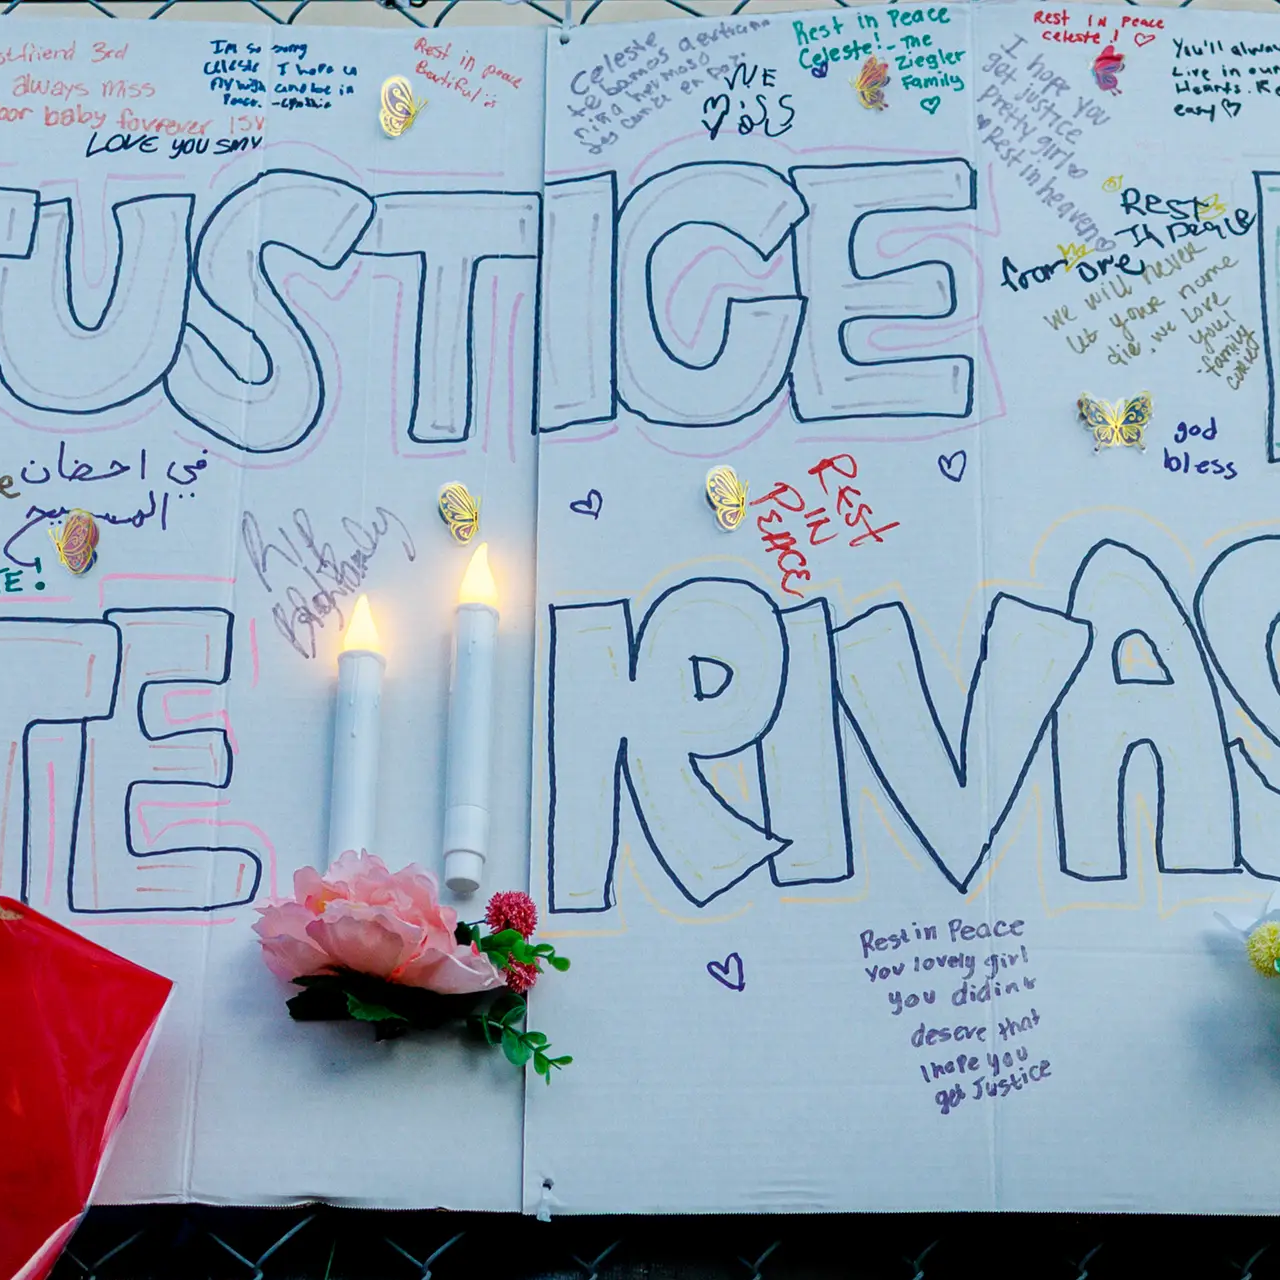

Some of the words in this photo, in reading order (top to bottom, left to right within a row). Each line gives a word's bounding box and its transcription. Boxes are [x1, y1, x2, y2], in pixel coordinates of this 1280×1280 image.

[792, 16, 844, 46] Rest
[857, 12, 879, 29] in
[414, 36, 452, 60] Rest
[459, 49, 476, 72] in
[570, 31, 658, 96] Celeste
[1000, 33, 1028, 59] I
[1026, 53, 1072, 97] hope
[1222, 64, 1241, 78] in
[901, 70, 965, 91] Family
[982, 52, 1017, 85] get
[1014, 82, 1083, 145] justice
[43, 102, 107, 130] baby
[1030, 135, 1075, 170] girl
[982, 126, 1022, 168] Rest
[1036, 176, 1100, 243] heaven
[1084, 275, 1132, 312] will
[1177, 254, 1239, 301] name
[1173, 416, 1217, 444] god
[20, 441, 146, 484] احضان
[167, 448, 208, 498] في
[1163, 447, 1238, 480] bless
[804, 507, 839, 546] IN
[859, 928, 910, 959] Rest
[911, 921, 937, 940] in
[948, 918, 1025, 942] Peace
[865, 962, 905, 983] you
[914, 952, 975, 980] lovely
[984, 945, 1029, 980] girl
[888, 989, 936, 1016] you
[999, 1008, 1041, 1041] that
[986, 1046, 1029, 1077] you
[935, 1083, 966, 1115] get
